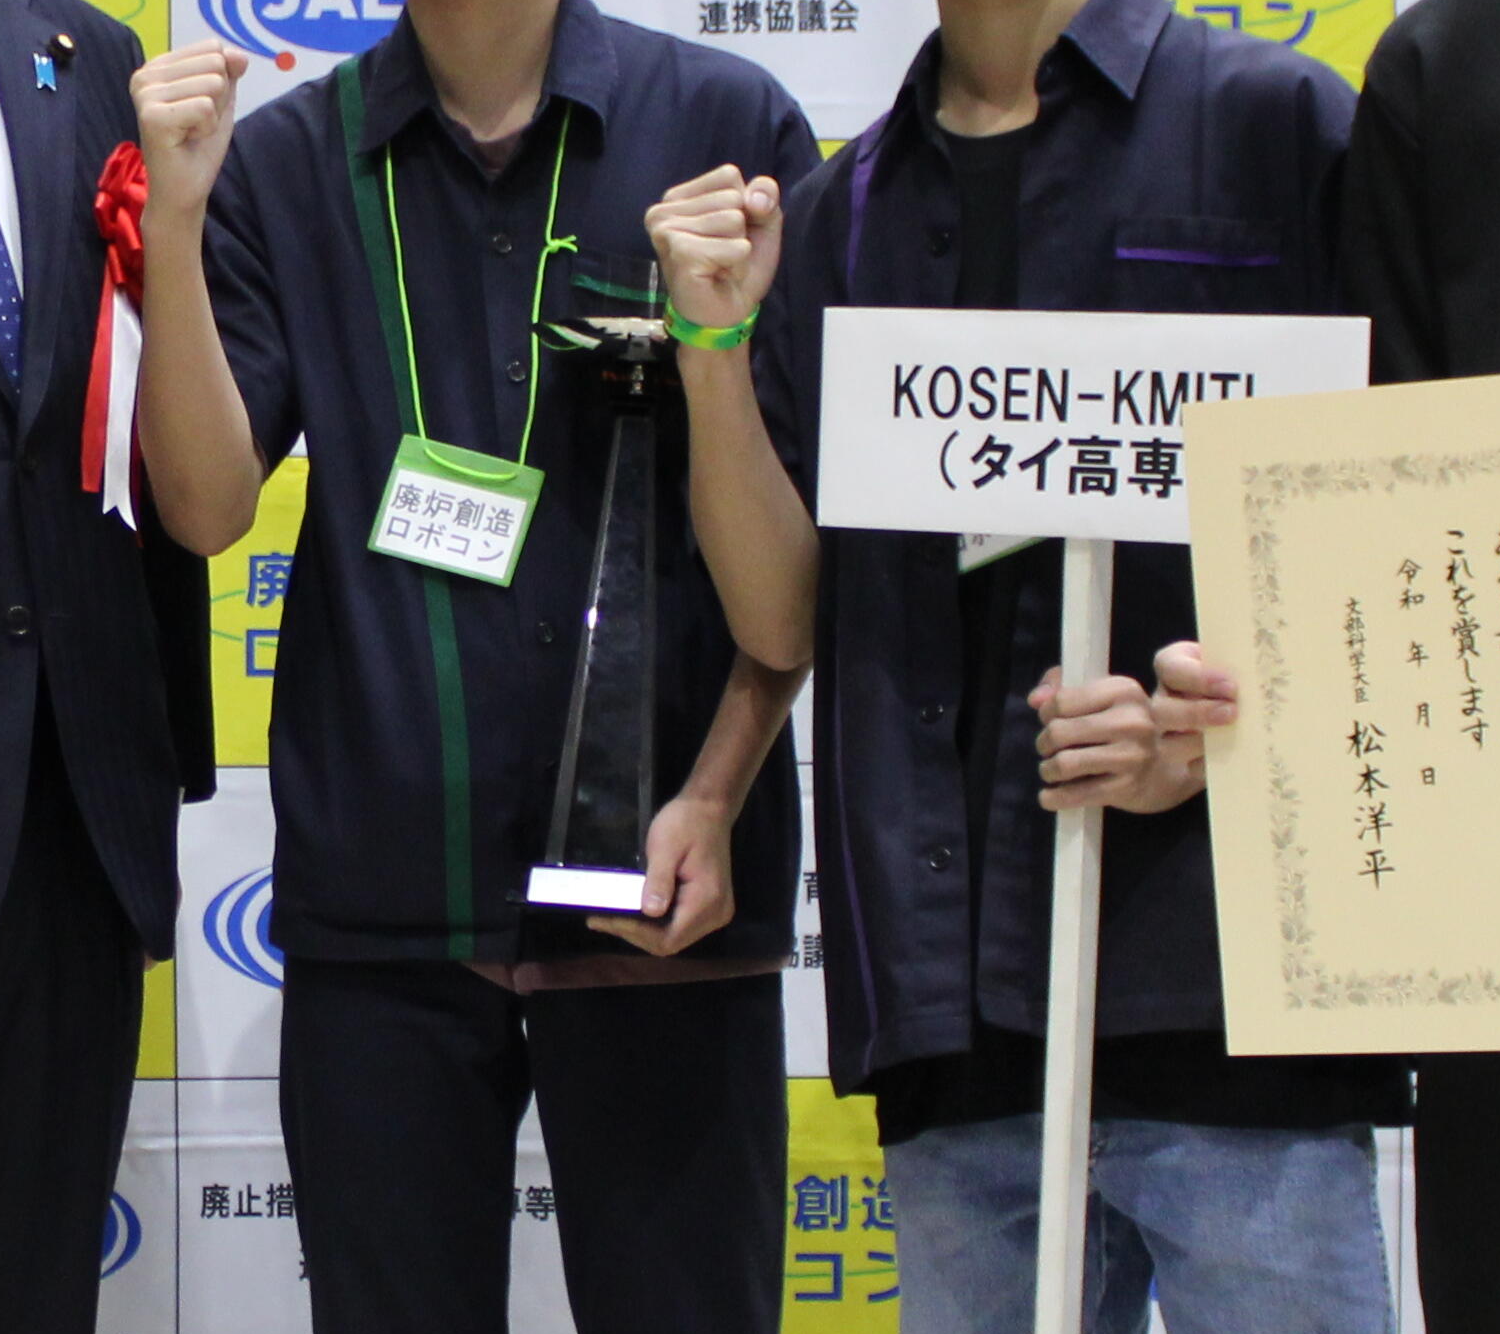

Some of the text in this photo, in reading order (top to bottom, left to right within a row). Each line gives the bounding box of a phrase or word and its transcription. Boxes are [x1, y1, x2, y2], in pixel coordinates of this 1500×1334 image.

[386, 516, 505, 562] ロボコン
[391, 483, 515, 539] 廃炉創造
[1397, 558, 1436, 786] 令和 年 月 日
[1446, 529, 1489, 751] これを賞します
[1346, 720, 1396, 892] 松本洋平
